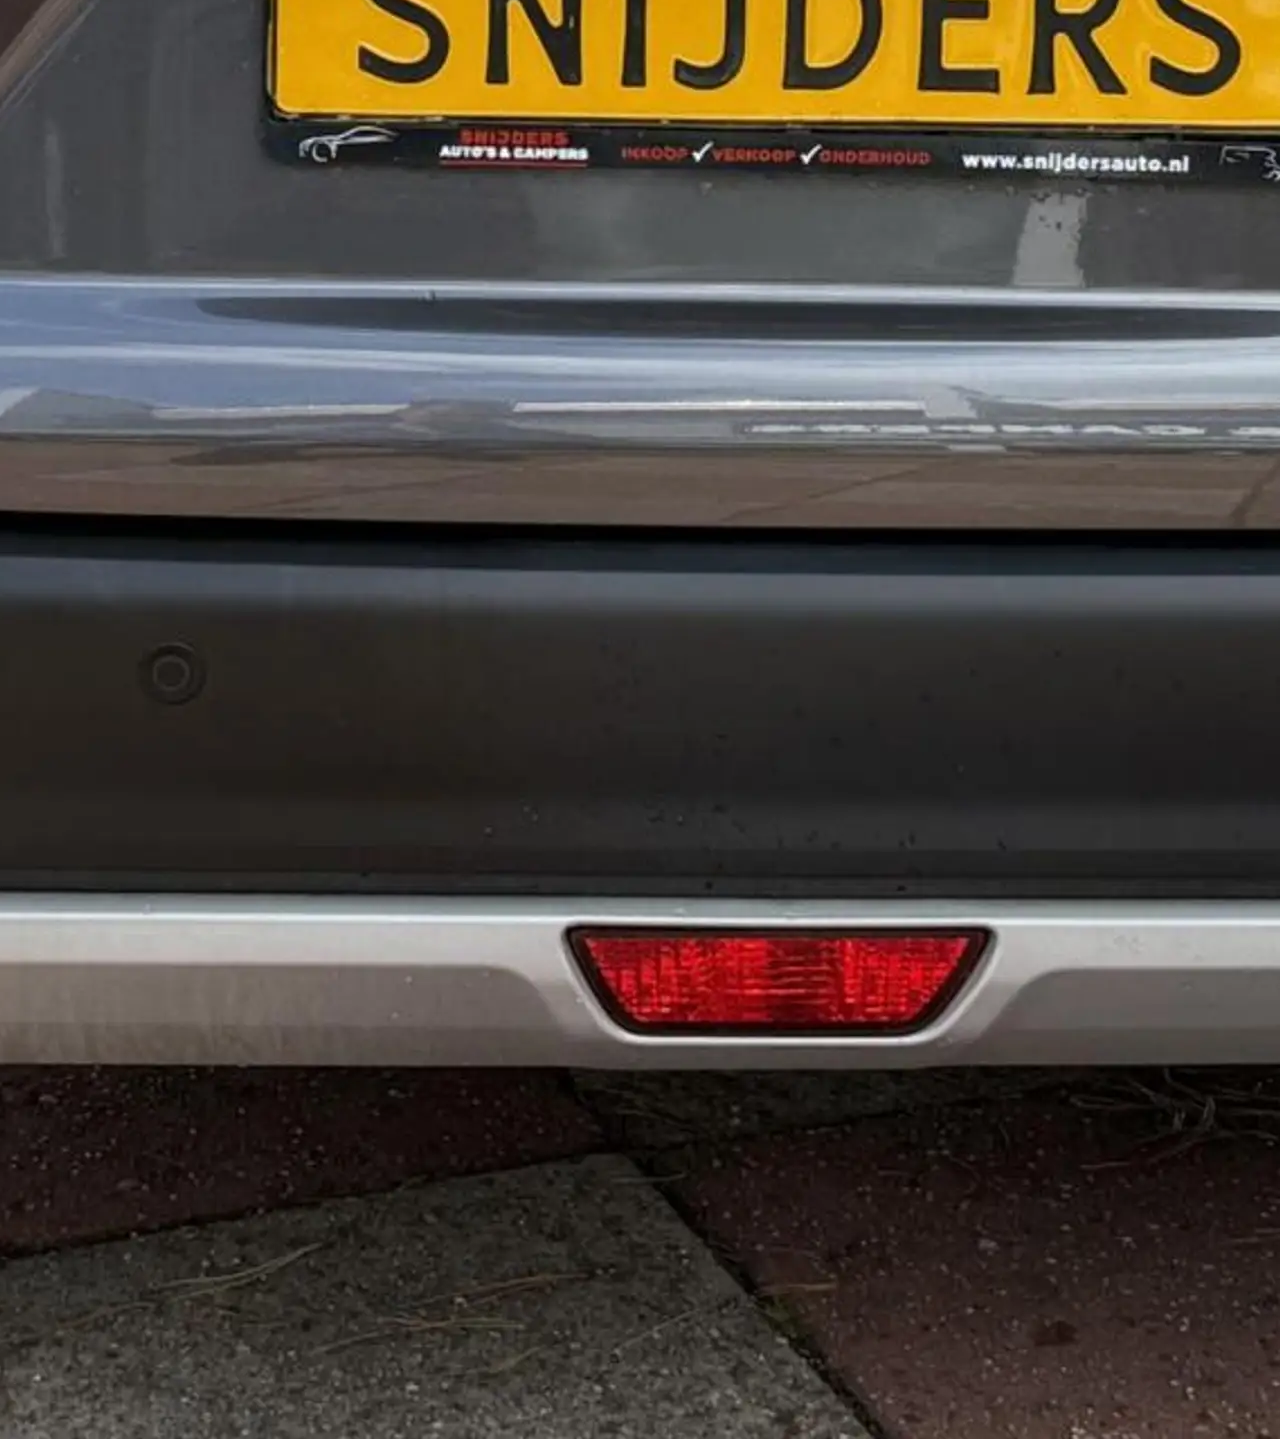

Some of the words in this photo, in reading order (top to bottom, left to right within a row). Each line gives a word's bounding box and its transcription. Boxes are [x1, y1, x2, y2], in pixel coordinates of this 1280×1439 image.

[458, 127, 571, 146] SNIJDERS
[439, 144, 497, 159] AUTO'S
[513, 146, 590, 161] CAMPERS
[712, 147, 797, 162] VERKOOP
[820, 149, 933, 165] ONDERHOUD
[961, 151, 1191, 174] www.snijdersauto.nl
